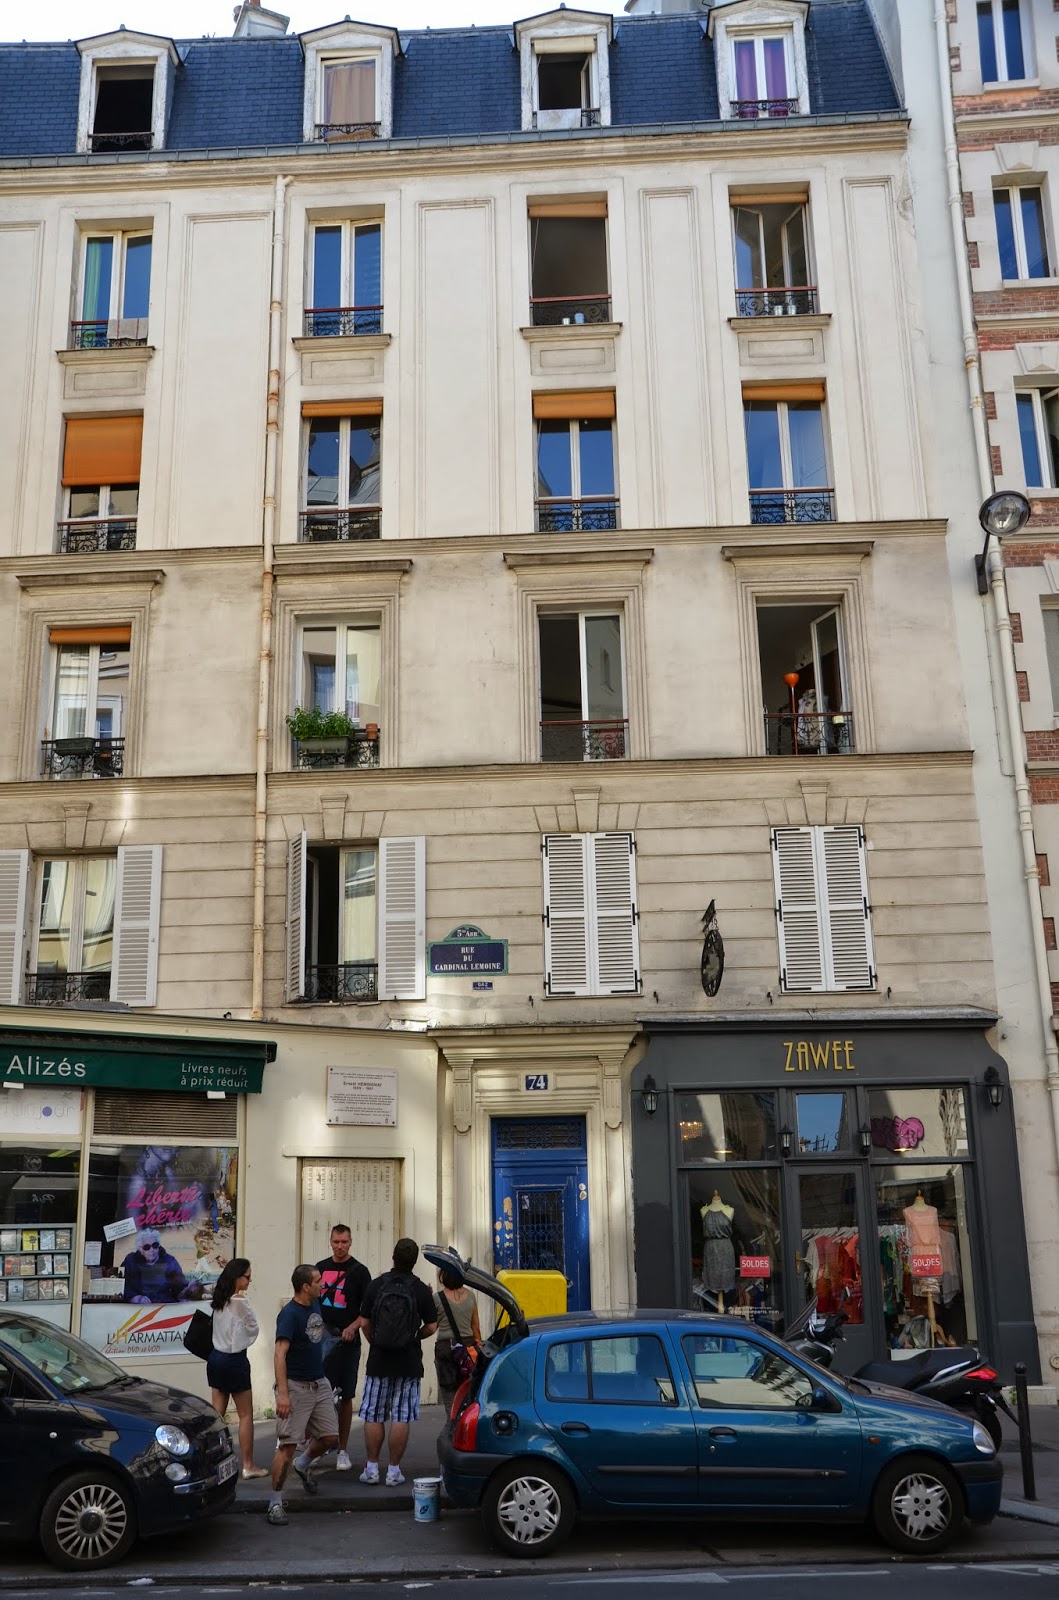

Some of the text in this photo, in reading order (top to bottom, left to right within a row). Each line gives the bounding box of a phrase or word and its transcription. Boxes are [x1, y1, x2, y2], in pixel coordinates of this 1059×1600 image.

[461, 946, 475, 954] RUE
[435, 962, 501, 971] CARDINAL LEMOINE
[783, 1040, 856, 1072] ZAWEE
[5, 1054, 87, 1078] Alizés
[181, 1062, 248, 1076] Livres neufs
[180, 1075, 249, 1088] à prix réduit
[528, 1075, 546, 1090] 74
[126, 1184, 198, 1209] Liberté
[135, 1205, 193, 1227] chérie
[741, 1259, 770, 1268] SOLDES
[912, 1258, 941, 1267] SOLDES
[127, 1345, 140, 1354] DVD
[147, 1345, 160, 1353] VOD
